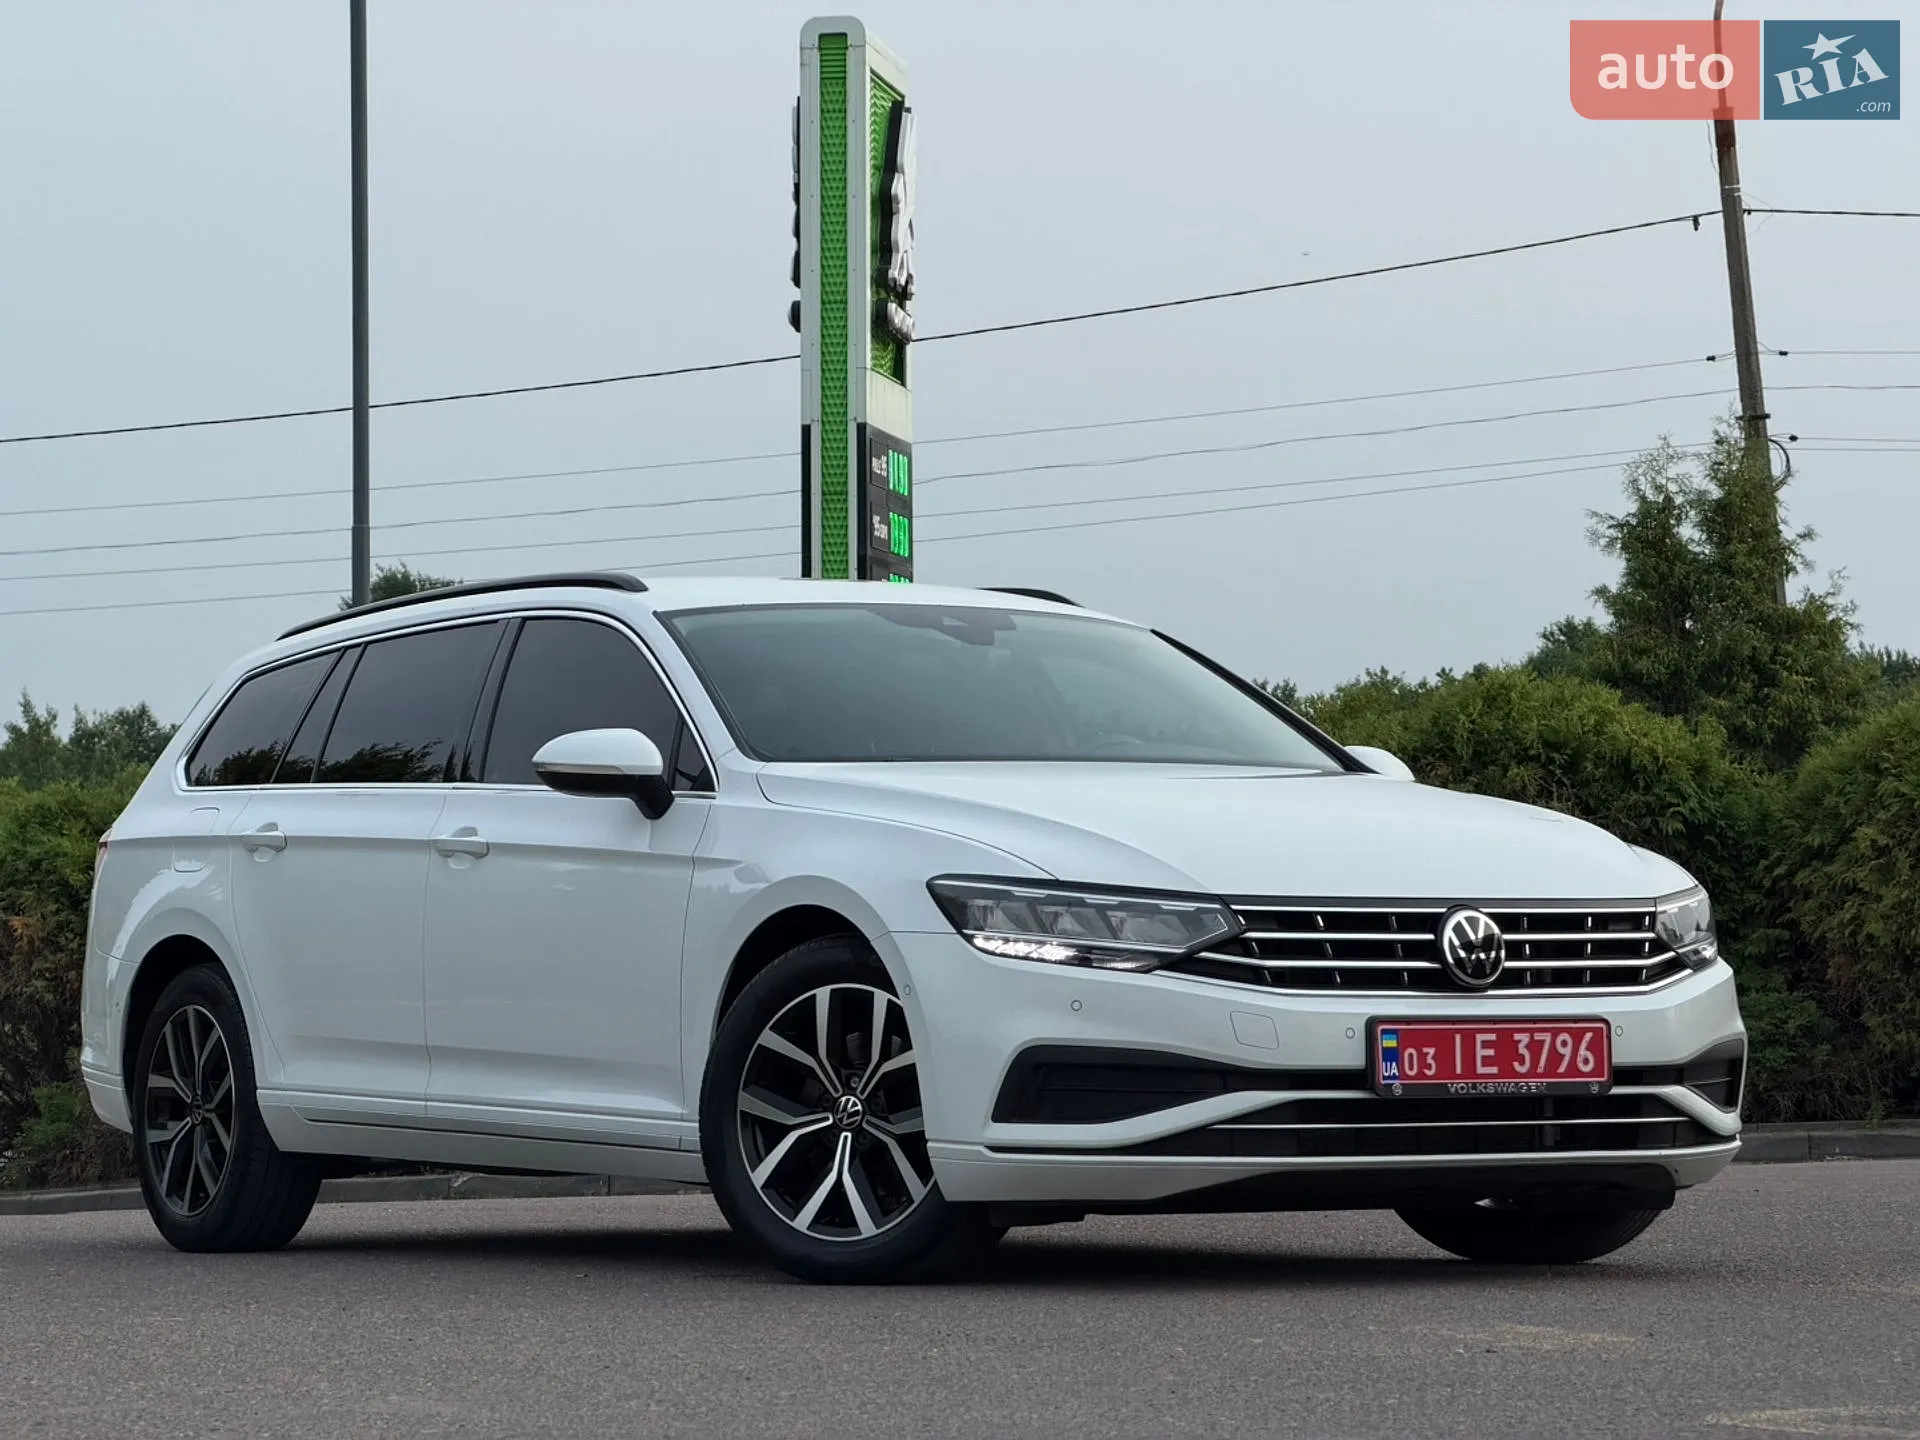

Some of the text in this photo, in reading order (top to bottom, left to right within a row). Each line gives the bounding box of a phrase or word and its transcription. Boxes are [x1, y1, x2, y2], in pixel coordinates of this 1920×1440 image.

[1403, 1031, 1595, 1076] 03 IE 3796
[1382, 1060, 1399, 1077] UA
[1448, 1082, 1547, 1094] VOLKSWAGEN
